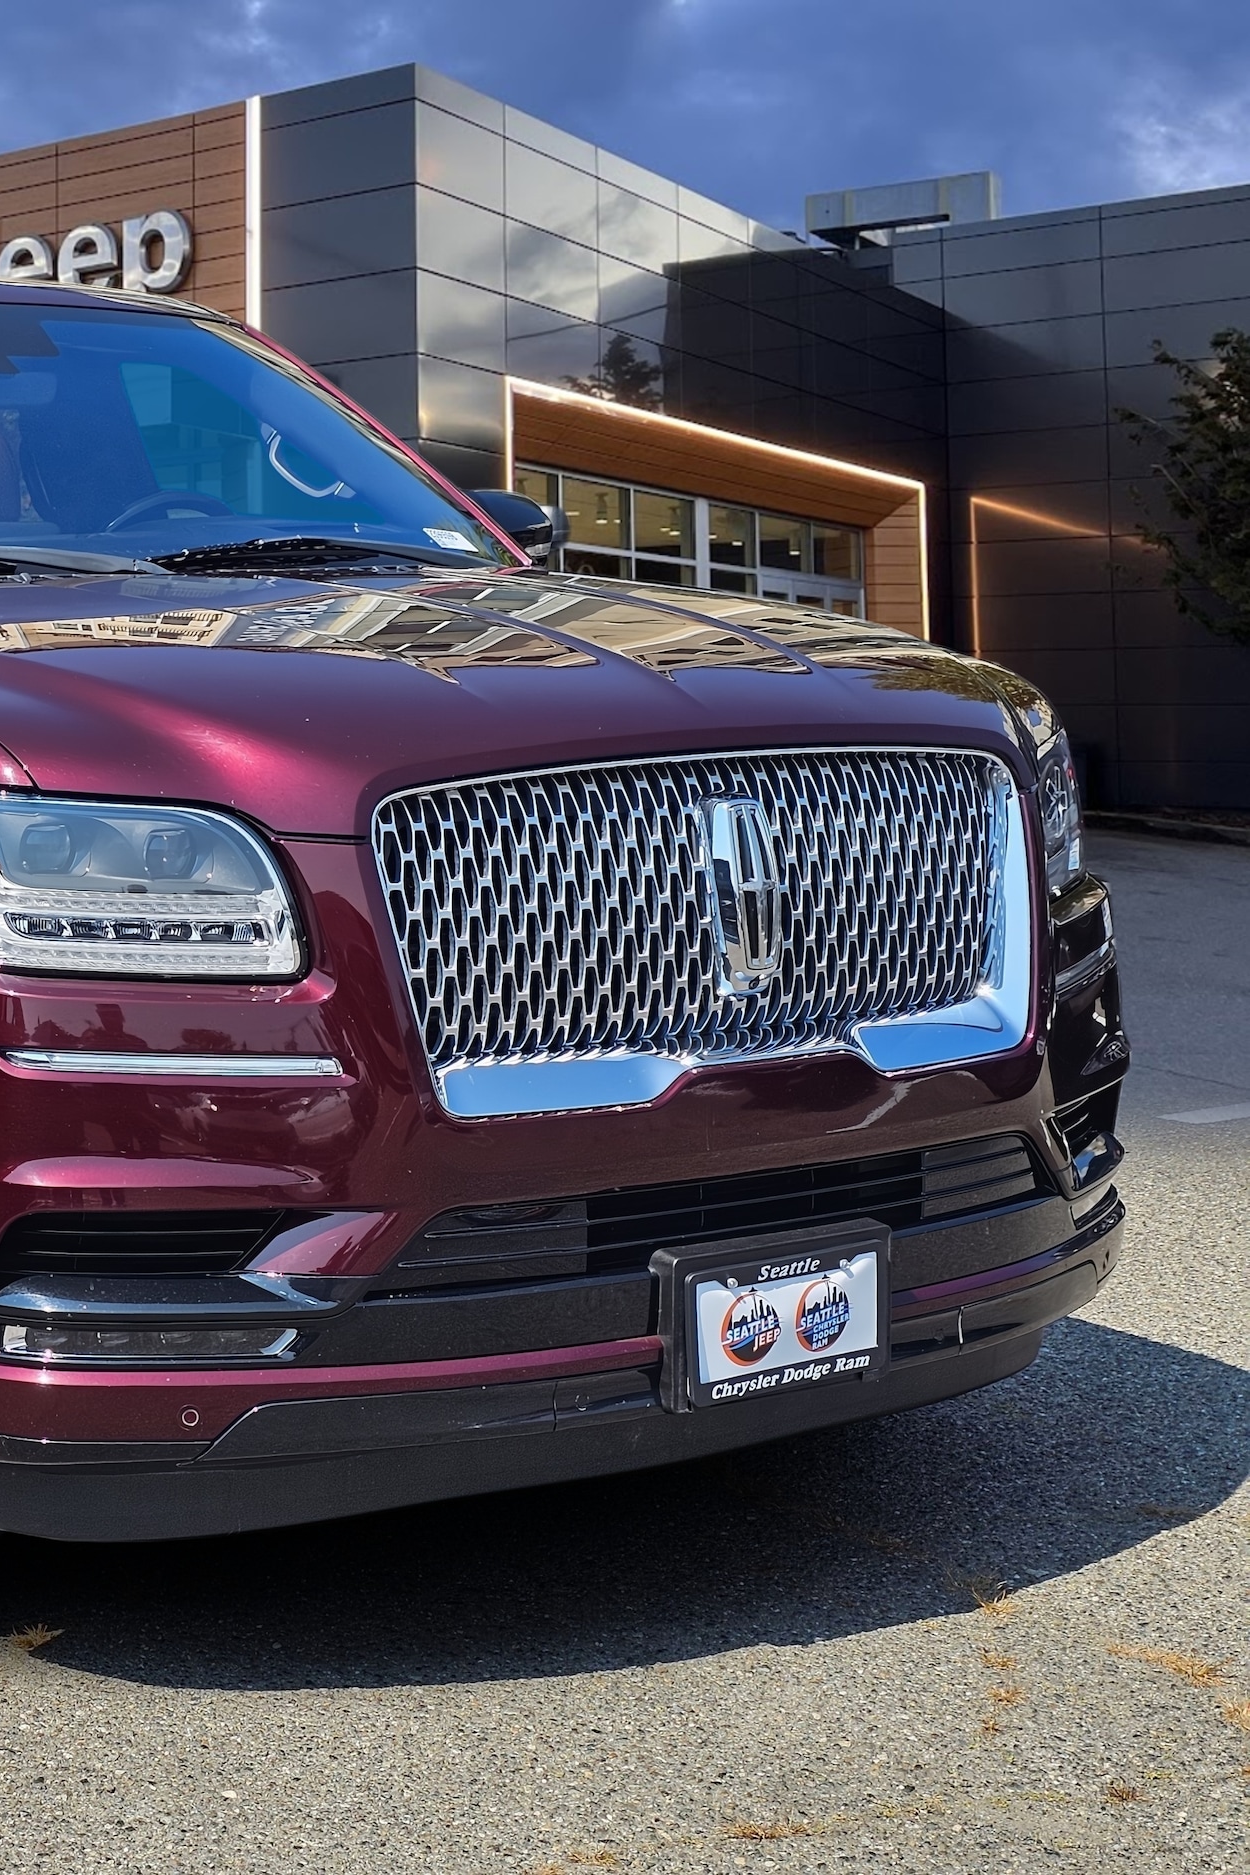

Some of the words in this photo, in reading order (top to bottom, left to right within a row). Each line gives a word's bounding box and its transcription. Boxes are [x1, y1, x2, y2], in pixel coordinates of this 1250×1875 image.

[758, 1257, 821, 1281] Seattle
[799, 1302, 846, 1330] SEATTLE
[812, 1313, 851, 1333] CHRYSLER
[725, 1314, 775, 1343] SEATTLE
[752, 1327, 782, 1352] JEEP
[811, 1325, 839, 1342] DODGE
[811, 1338, 829, 1351] RAM
[711, 1374, 781, 1401] Chrysler
[781, 1361, 831, 1386] Dodge
[834, 1355, 871, 1373] Ram
